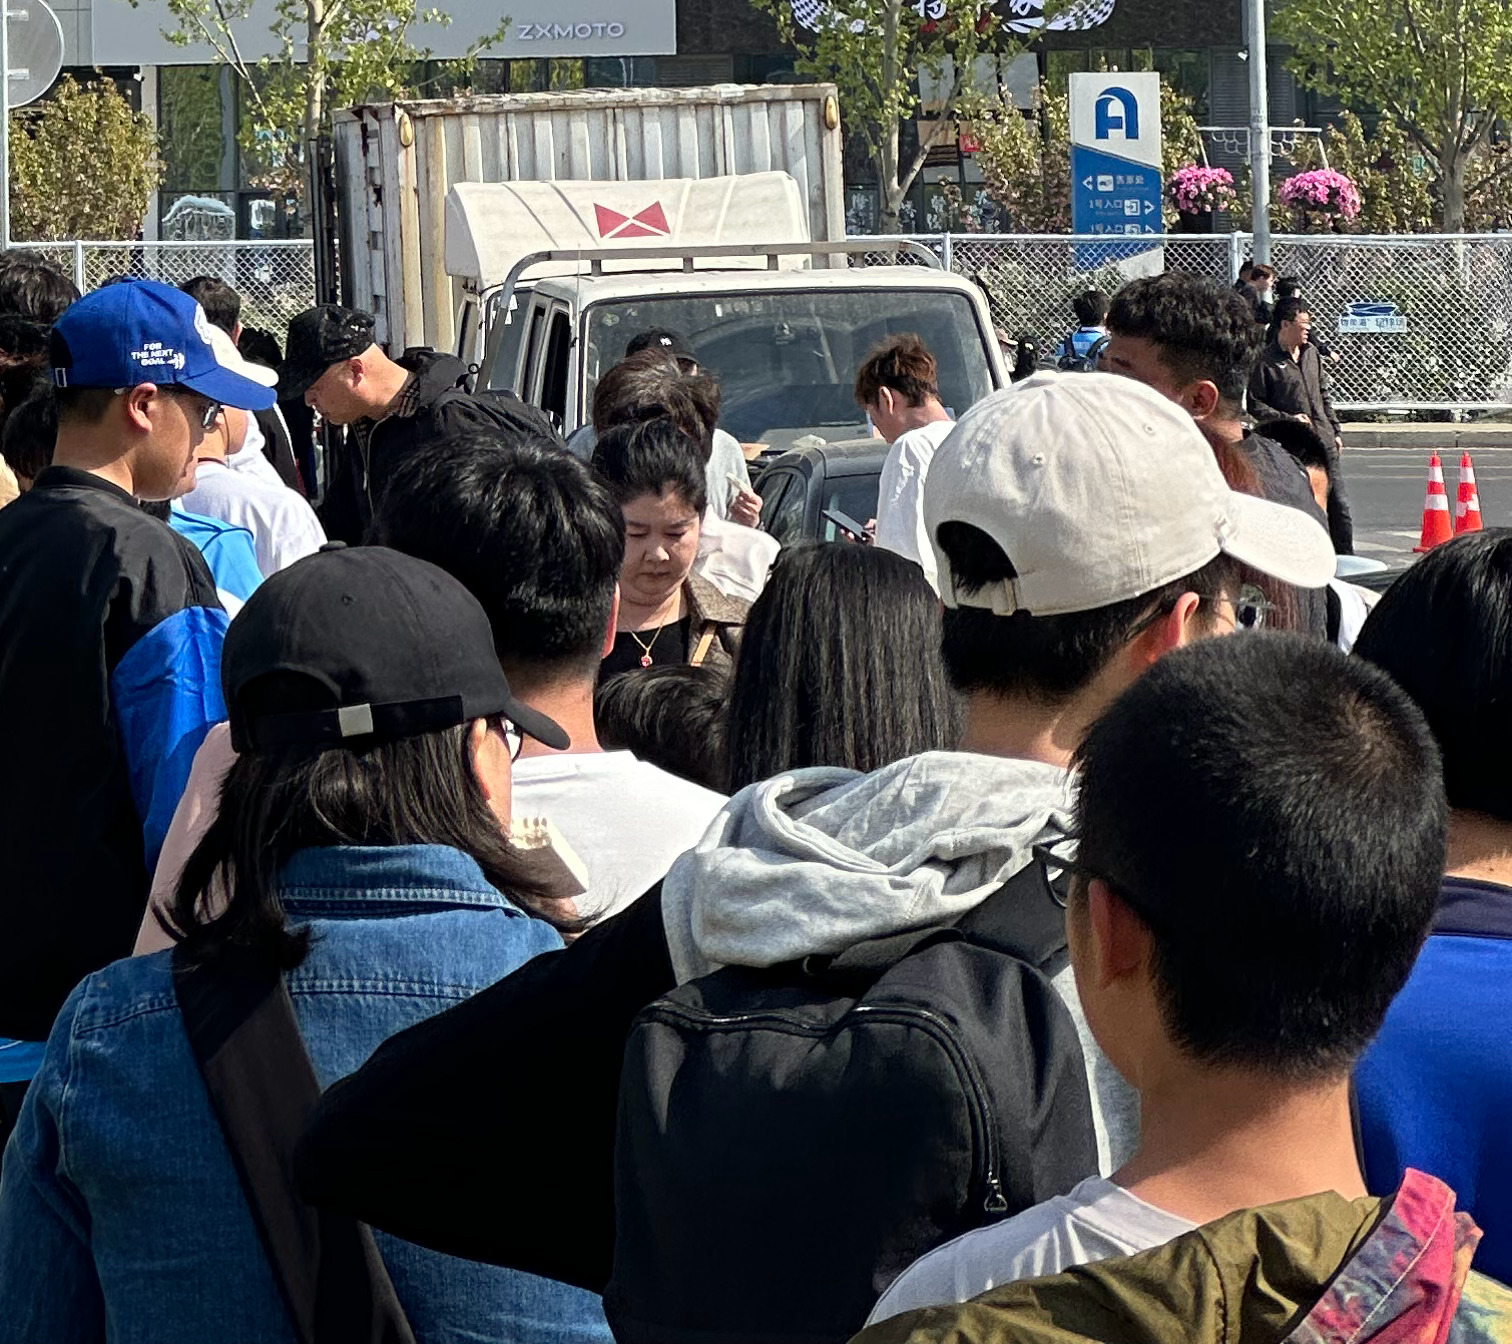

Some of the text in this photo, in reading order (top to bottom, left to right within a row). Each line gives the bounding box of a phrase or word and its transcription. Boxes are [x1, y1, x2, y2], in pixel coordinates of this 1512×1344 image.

[517, 22, 625, 40] ZXMOTO
[143, 342, 163, 351] FOR
[131, 348, 173, 360] THE NEXT
[140, 357, 166, 366] GOAL
